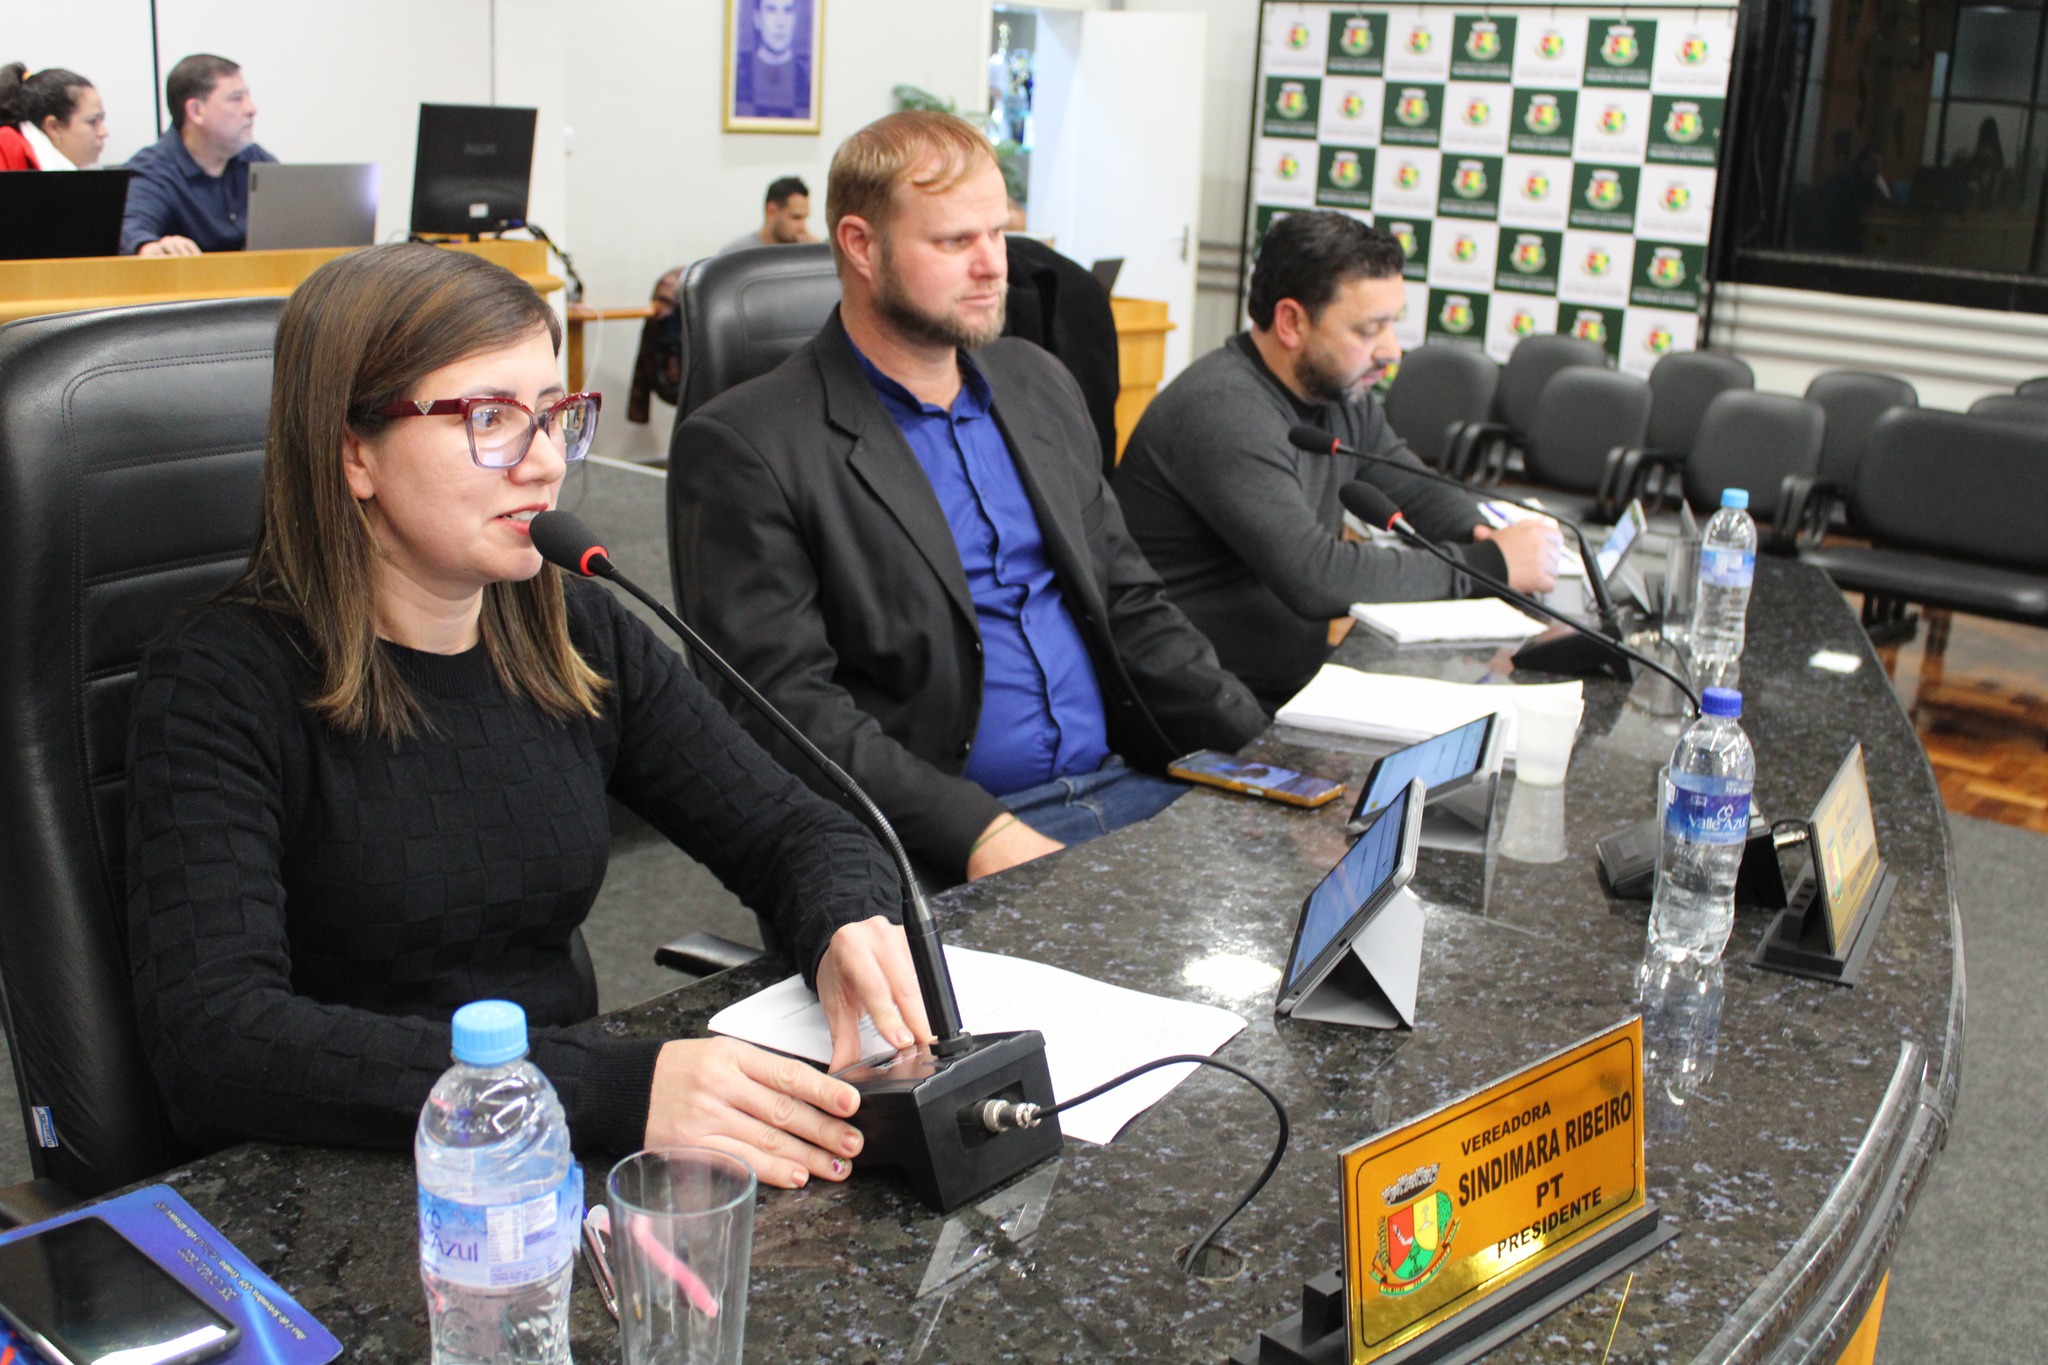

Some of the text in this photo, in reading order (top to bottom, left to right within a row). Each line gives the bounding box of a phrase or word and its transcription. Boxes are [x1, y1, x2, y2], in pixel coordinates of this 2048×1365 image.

[1689, 814, 1747, 831] Valle Azul
[1459, 1091, 1632, 1207] SINDIMARA RIBEIRO
[1461, 1101, 1552, 1157] VEREADORA
[1536, 1172, 1564, 1208] PT
[1497, 1186, 1602, 1259] PRESIDENTE
[431, 1234, 479, 1263] Azul
